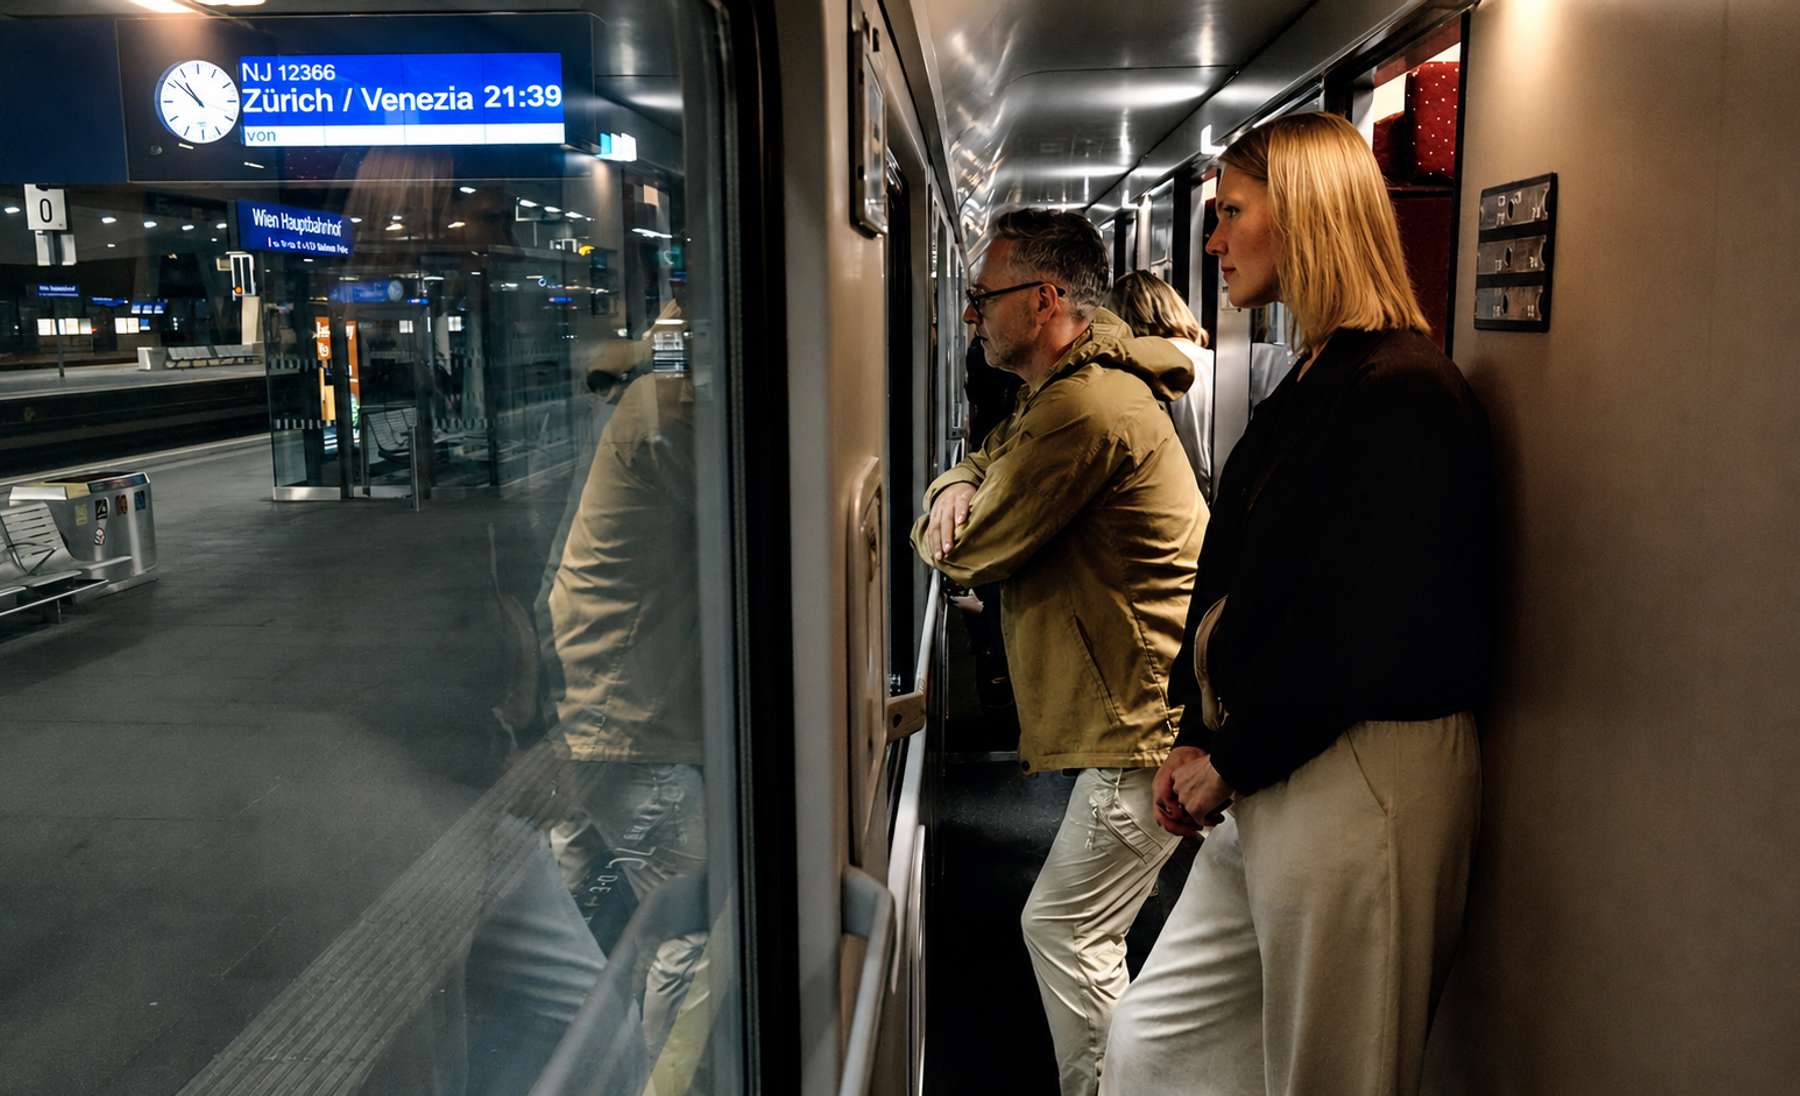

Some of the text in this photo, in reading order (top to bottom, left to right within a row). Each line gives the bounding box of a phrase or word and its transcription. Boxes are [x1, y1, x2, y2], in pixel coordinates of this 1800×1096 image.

[242, 63, 336, 82] NJ 12366
[242, 87, 333, 113] Zürich
[361, 85, 474, 111] Venezia
[484, 84, 561, 108] 21:39
[247, 130, 276, 142] von
[40, 198, 52, 223] 0
[252, 208, 342, 237] Wien Hauptbahnhof
